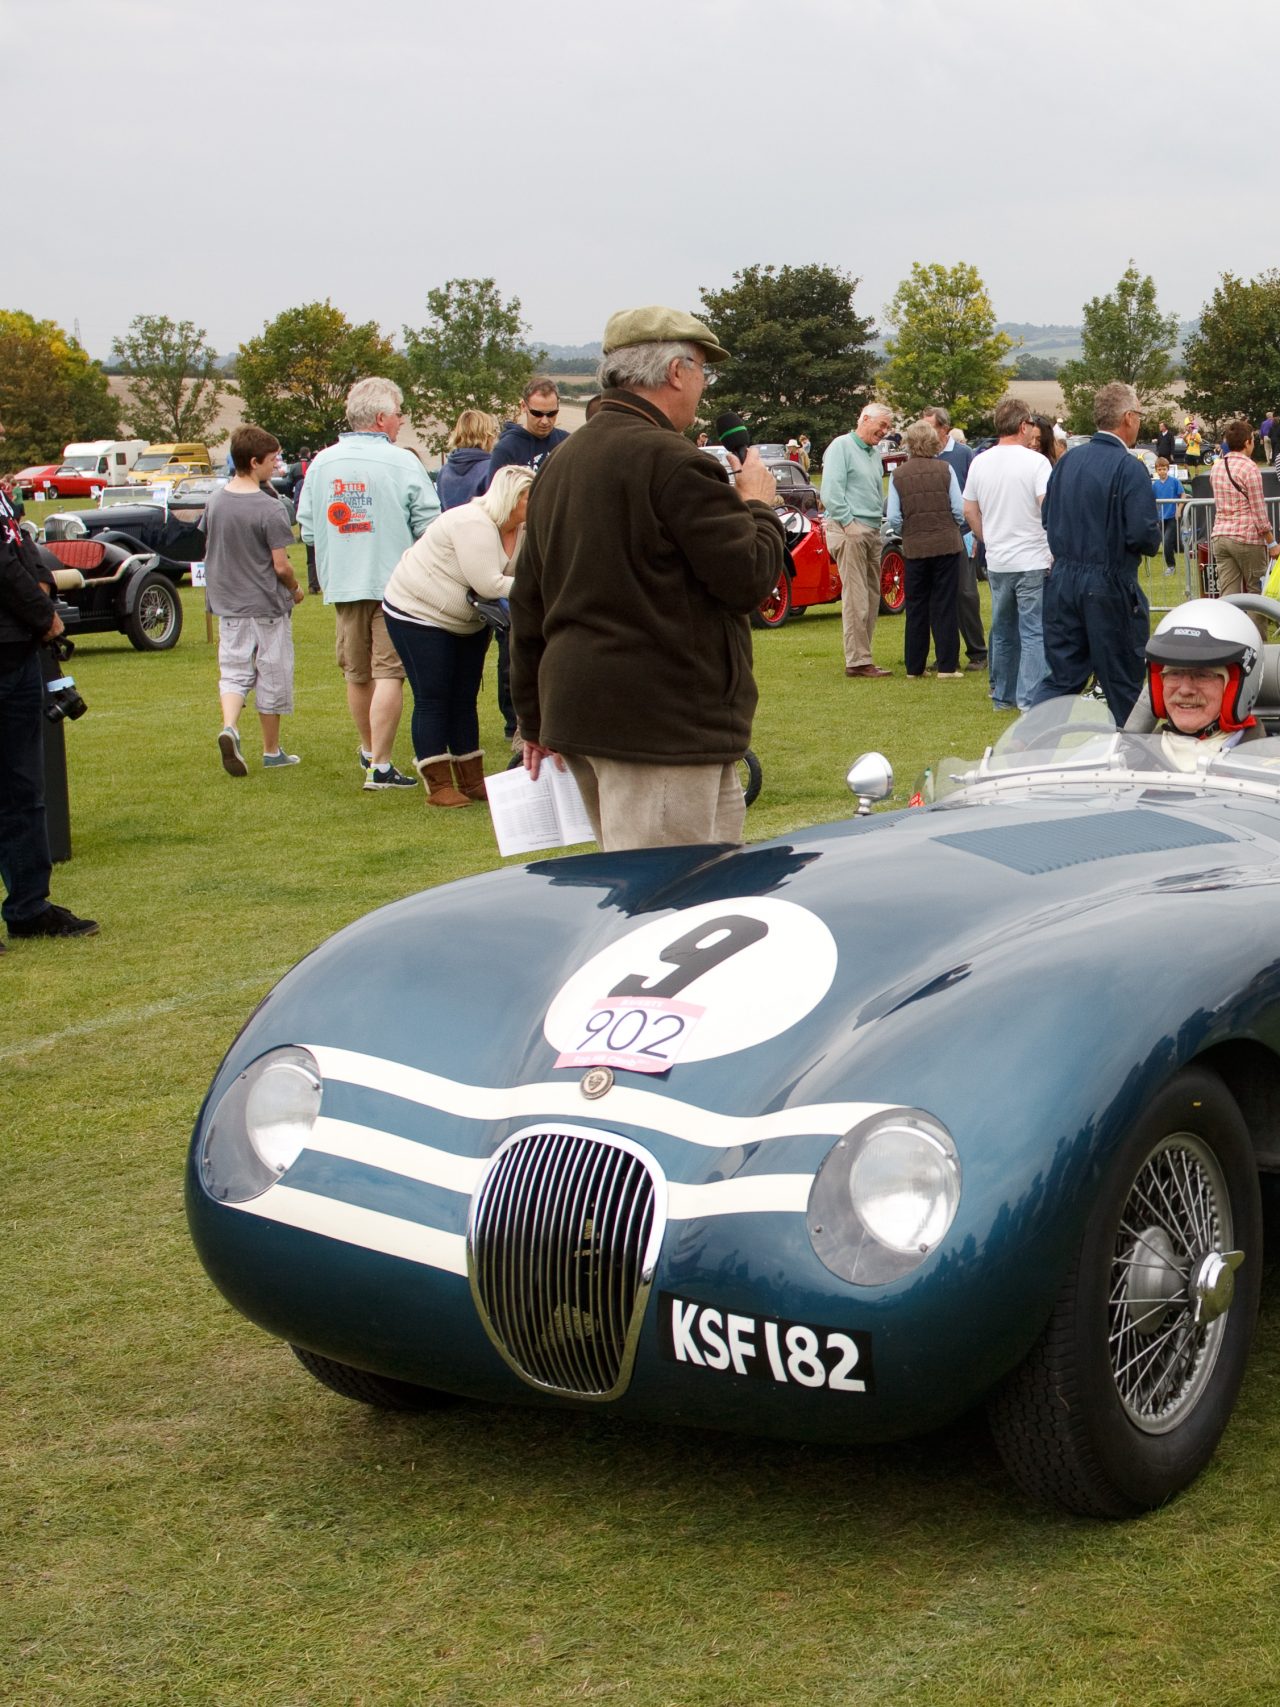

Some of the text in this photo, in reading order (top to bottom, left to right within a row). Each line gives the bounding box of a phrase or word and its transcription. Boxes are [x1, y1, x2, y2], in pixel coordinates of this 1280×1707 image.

[607, 914, 769, 999] 9
[576, 1009, 685, 1059] 902
[672, 1298, 867, 1393] KSF 182
